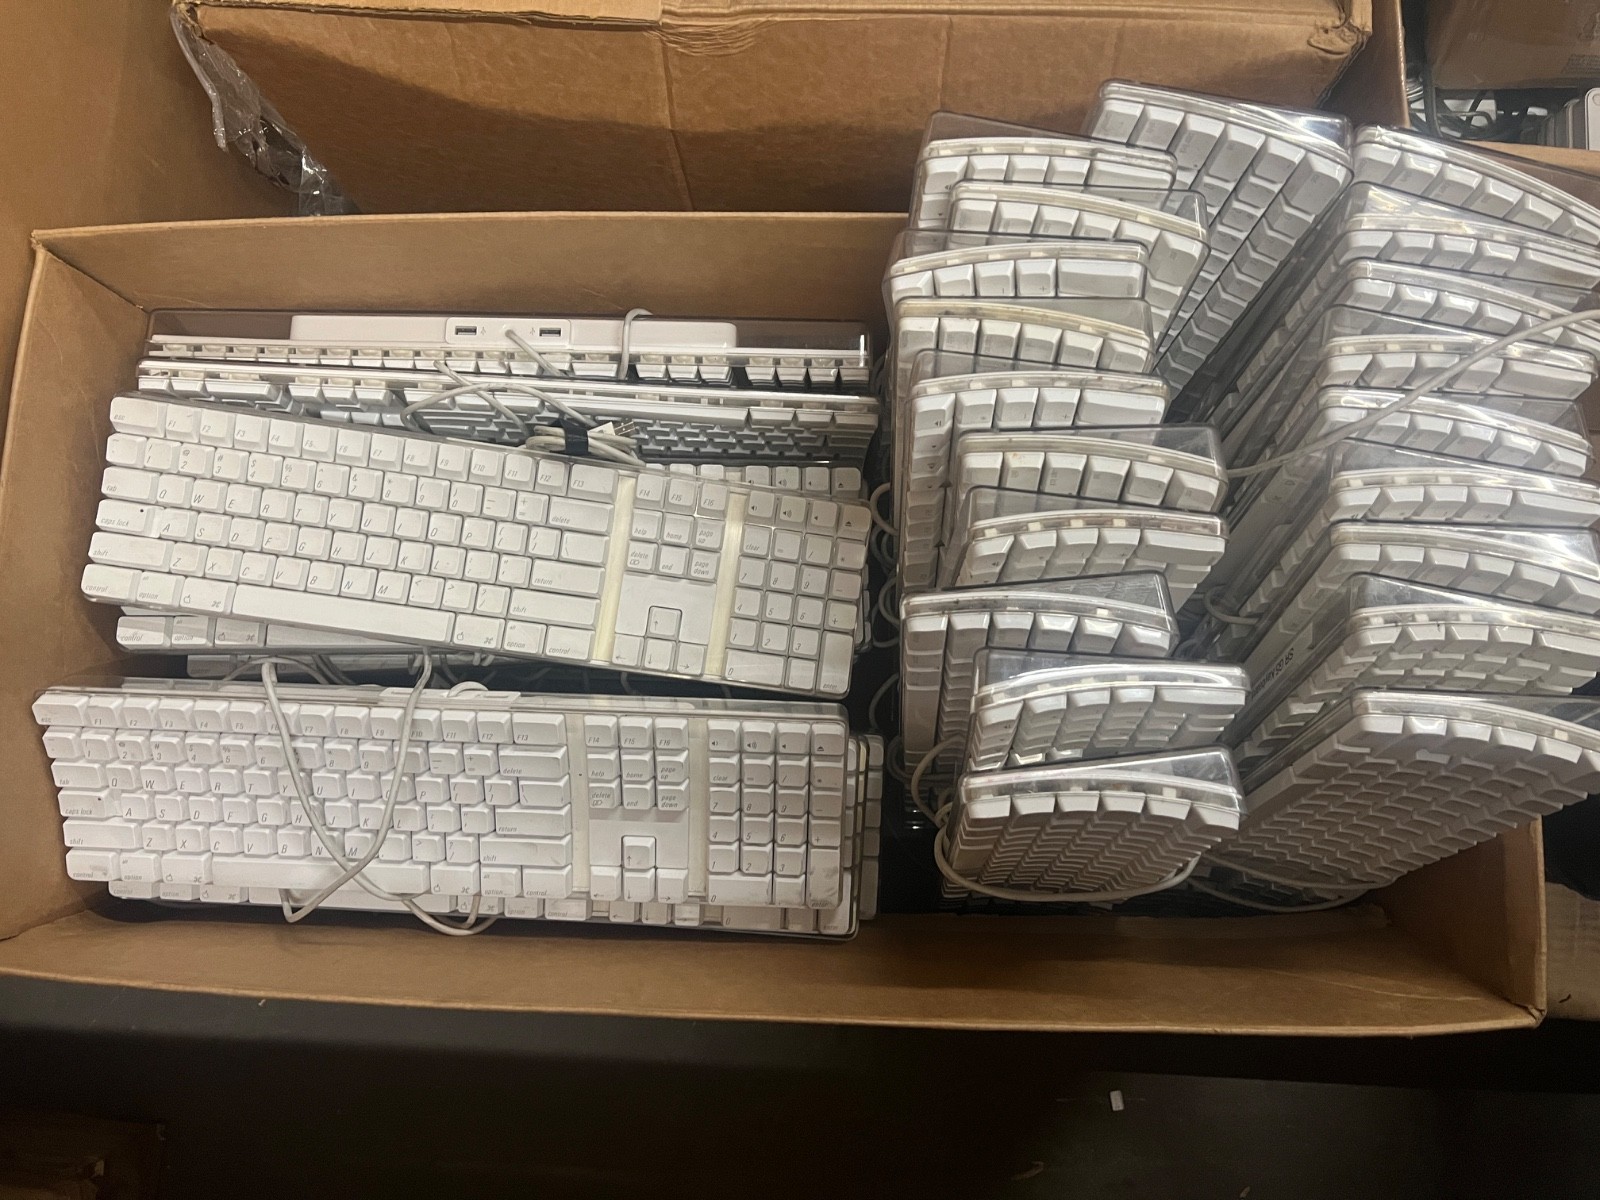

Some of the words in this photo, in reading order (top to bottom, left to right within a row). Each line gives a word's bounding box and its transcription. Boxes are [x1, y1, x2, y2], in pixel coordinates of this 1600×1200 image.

[168, 420, 175, 428] F1
[202, 425, 211, 433] F2
[271, 434, 280, 442] F4
[339, 445, 348, 453] F6
[373, 449, 382, 457] F7
[406, 454, 415, 462] F8
[181, 461, 187, 469] 2
[473, 464, 485, 472] F10
[215, 466, 222, 474] 3
[507, 469, 518, 477] F11
[283, 476, 288, 484] 5
[539, 474, 551, 482] F12
[573, 480, 584, 488] F13
[159, 490, 166, 499] Q
[384, 490, 391, 498] 8
[639, 488, 650, 496] F14
[193, 494, 204, 503] W
[418, 495, 425, 503] 9
[228, 499, 234, 508] E
[262, 504, 270, 513] R
[296, 509, 303, 518] T
[329, 513, 336, 521] Y
[364, 519, 371, 527] U
[551, 516, 571, 524] delete
[162, 523, 170, 532] A
[196, 528, 204, 537] S
[430, 528, 438, 537] O
[634, 528, 647, 536] help
[666, 532, 682, 540] home
[231, 533, 239, 542] D
[465, 532, 472, 541] P
[264, 537, 272, 546] F
[298, 542, 306, 551] G
[92, 548, 108, 556] shift
[332, 547, 341, 555] H
[630, 551, 648, 559] delete
[366, 552, 374, 561] J
[400, 556, 408, 565] K
[172, 557, 181, 567] Z
[433, 560, 440, 569] L
[694, 561, 709, 569] page
[208, 562, 217, 571] X
[242, 567, 250, 576] C
[276, 572, 284, 580] V
[310, 576, 318, 585] B
[85, 584, 108, 592] control
[344, 581, 353, 590] N
[378, 586, 388, 594] M
[138, 592, 158, 600] option
[768, 608, 773, 616] 5
[800, 612, 805, 620] 6
[549, 647, 570, 655] control
[111, 778, 118, 787] Q
[145, 780, 154, 789] W
[180, 781, 185, 790] E
[214, 782, 221, 791] R
[248, 784, 254, 792] T
[282, 785, 288, 794] Y
[316, 787, 323, 795] U
[420, 791, 426, 800] P
[125, 808, 132, 817] A
[159, 809, 165, 818] S
[193, 811, 200, 819] D
[227, 812, 234, 820] F
[261, 813, 267, 822] G
[295, 815, 302, 823] H
[329, 816, 335, 825] J
[363, 819, 368, 827] K
[397, 820, 401, 828] L
[145, 838, 153, 847] Z
[180, 840, 187, 849] X
[213, 842, 220, 850] C
[247, 843, 254, 852] V
[282, 844, 288, 853] B
[315, 847, 322, 855] N
[348, 848, 358, 856] M
